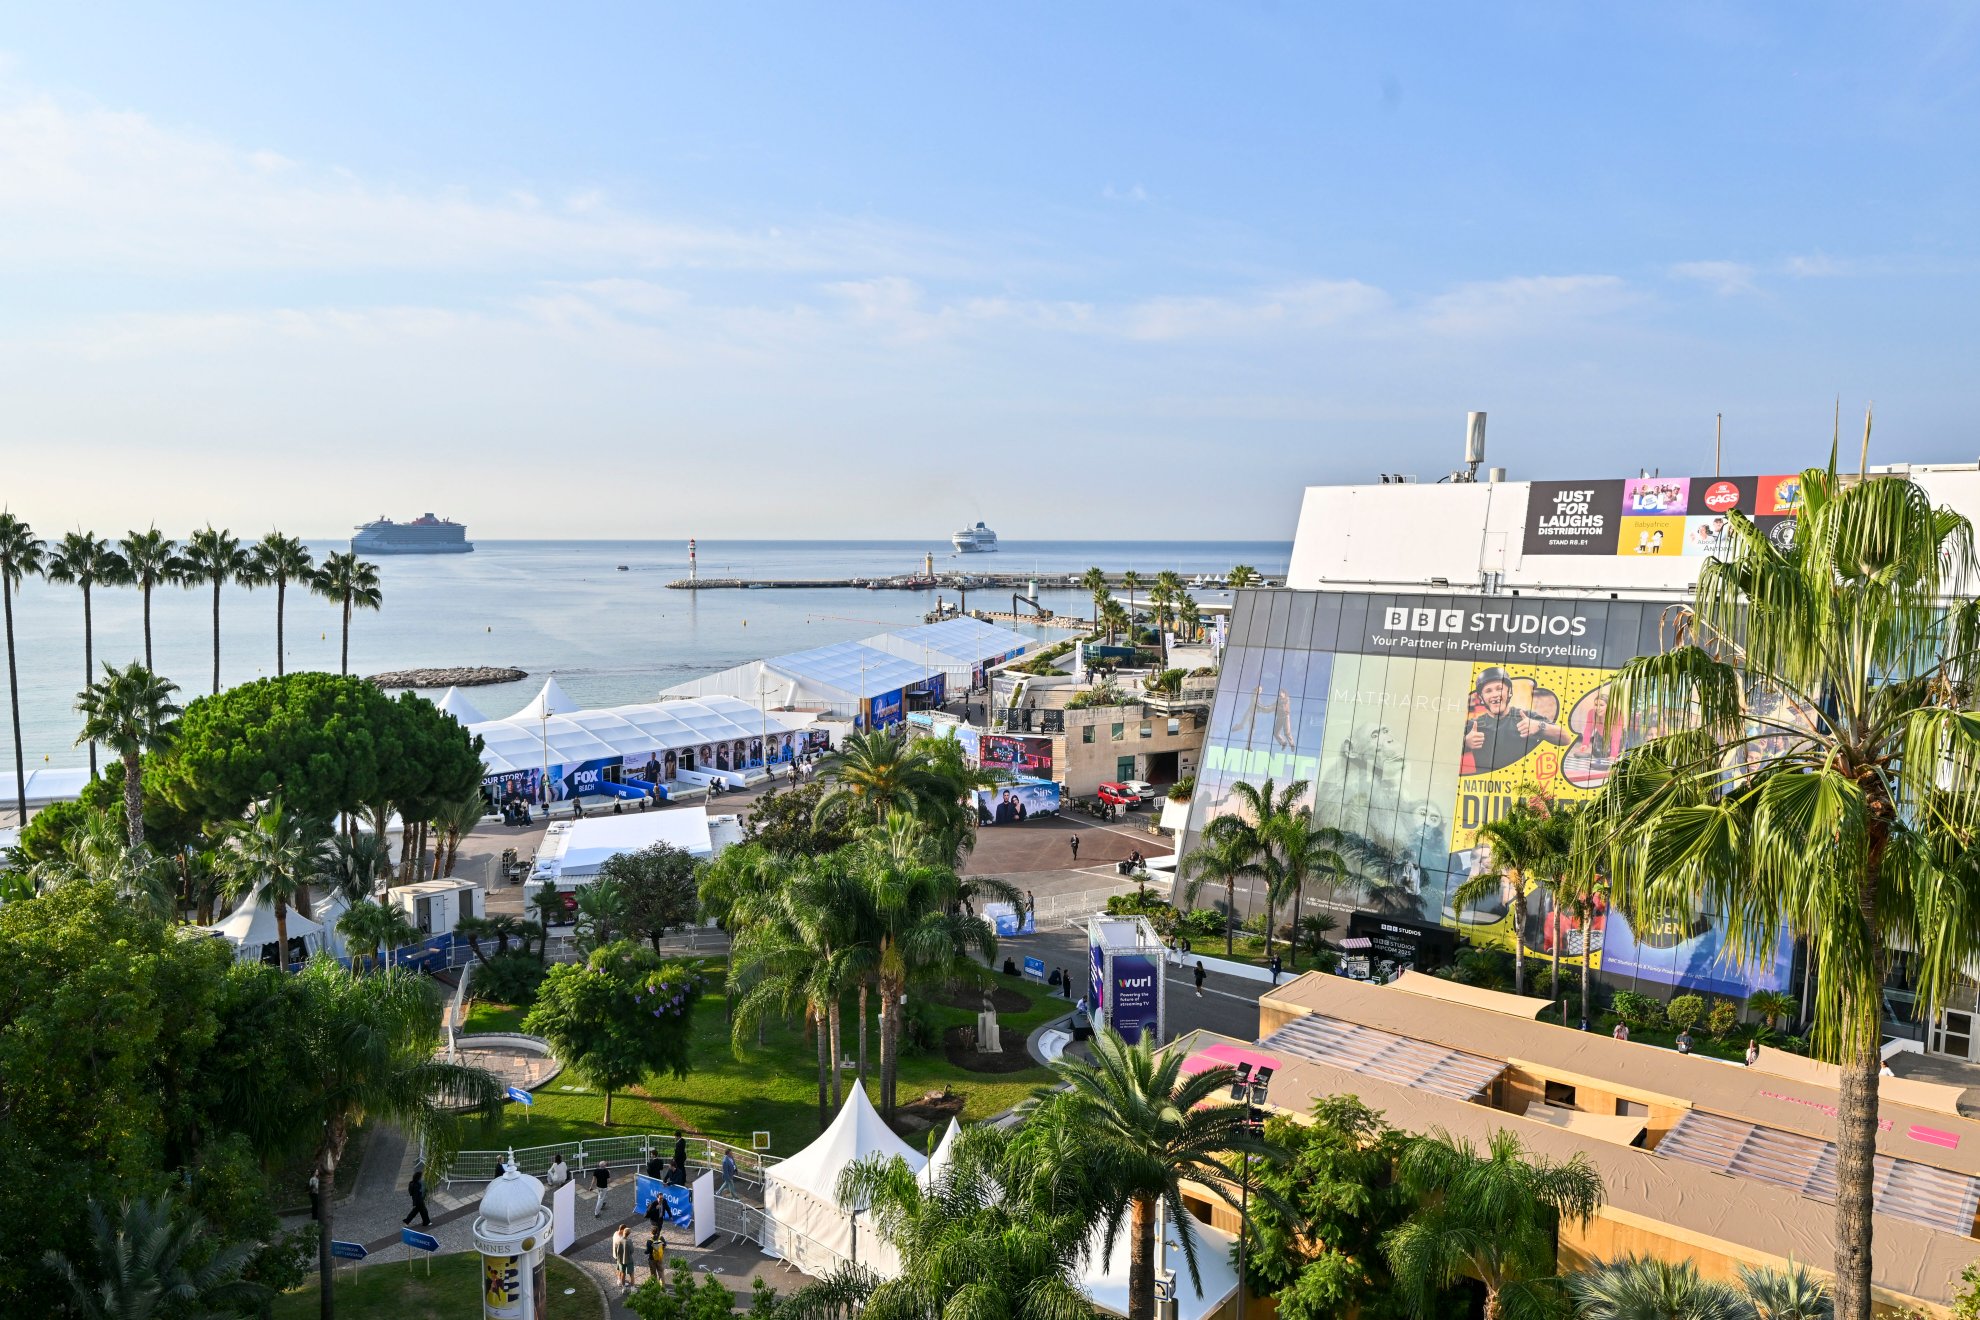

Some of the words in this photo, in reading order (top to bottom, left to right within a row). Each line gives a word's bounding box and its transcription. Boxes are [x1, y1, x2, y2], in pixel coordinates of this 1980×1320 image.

[1552, 490, 1595, 503] JUST
[1632, 492, 1668, 511] LOL
[1706, 493, 1739, 505] GAGS
[1556, 502, 1589, 515] FOR
[1538, 514, 1604, 527] LAUGHS
[1538, 527, 1603, 535] DISTRIBUTION
[1384, 607, 1465, 633] BBC
[1470, 612, 1587, 637] STUDIOS
[1372, 635, 1399, 646] Your
[1400, 636, 1444, 649] Partner
[1447, 639, 1458, 649] in
[1461, 640, 1517, 653] Premium
[1519, 643, 1598, 660] Storytelling
[1334, 688, 1461, 713] MATRIARCH
[1206, 745, 1317, 781] MINT
[574, 769, 599, 785] FOX
[579, 783, 595, 792] BEACH
[1033, 787, 1053, 797] Sins
[1463, 779, 1512, 793] NATION'S
[1030, 799, 1056, 809] Roses
[1398, 927, 1422, 936] STUDIOS
[1390, 941, 1416, 951] STUDIOS
[1118, 975, 1151, 988] wurl
